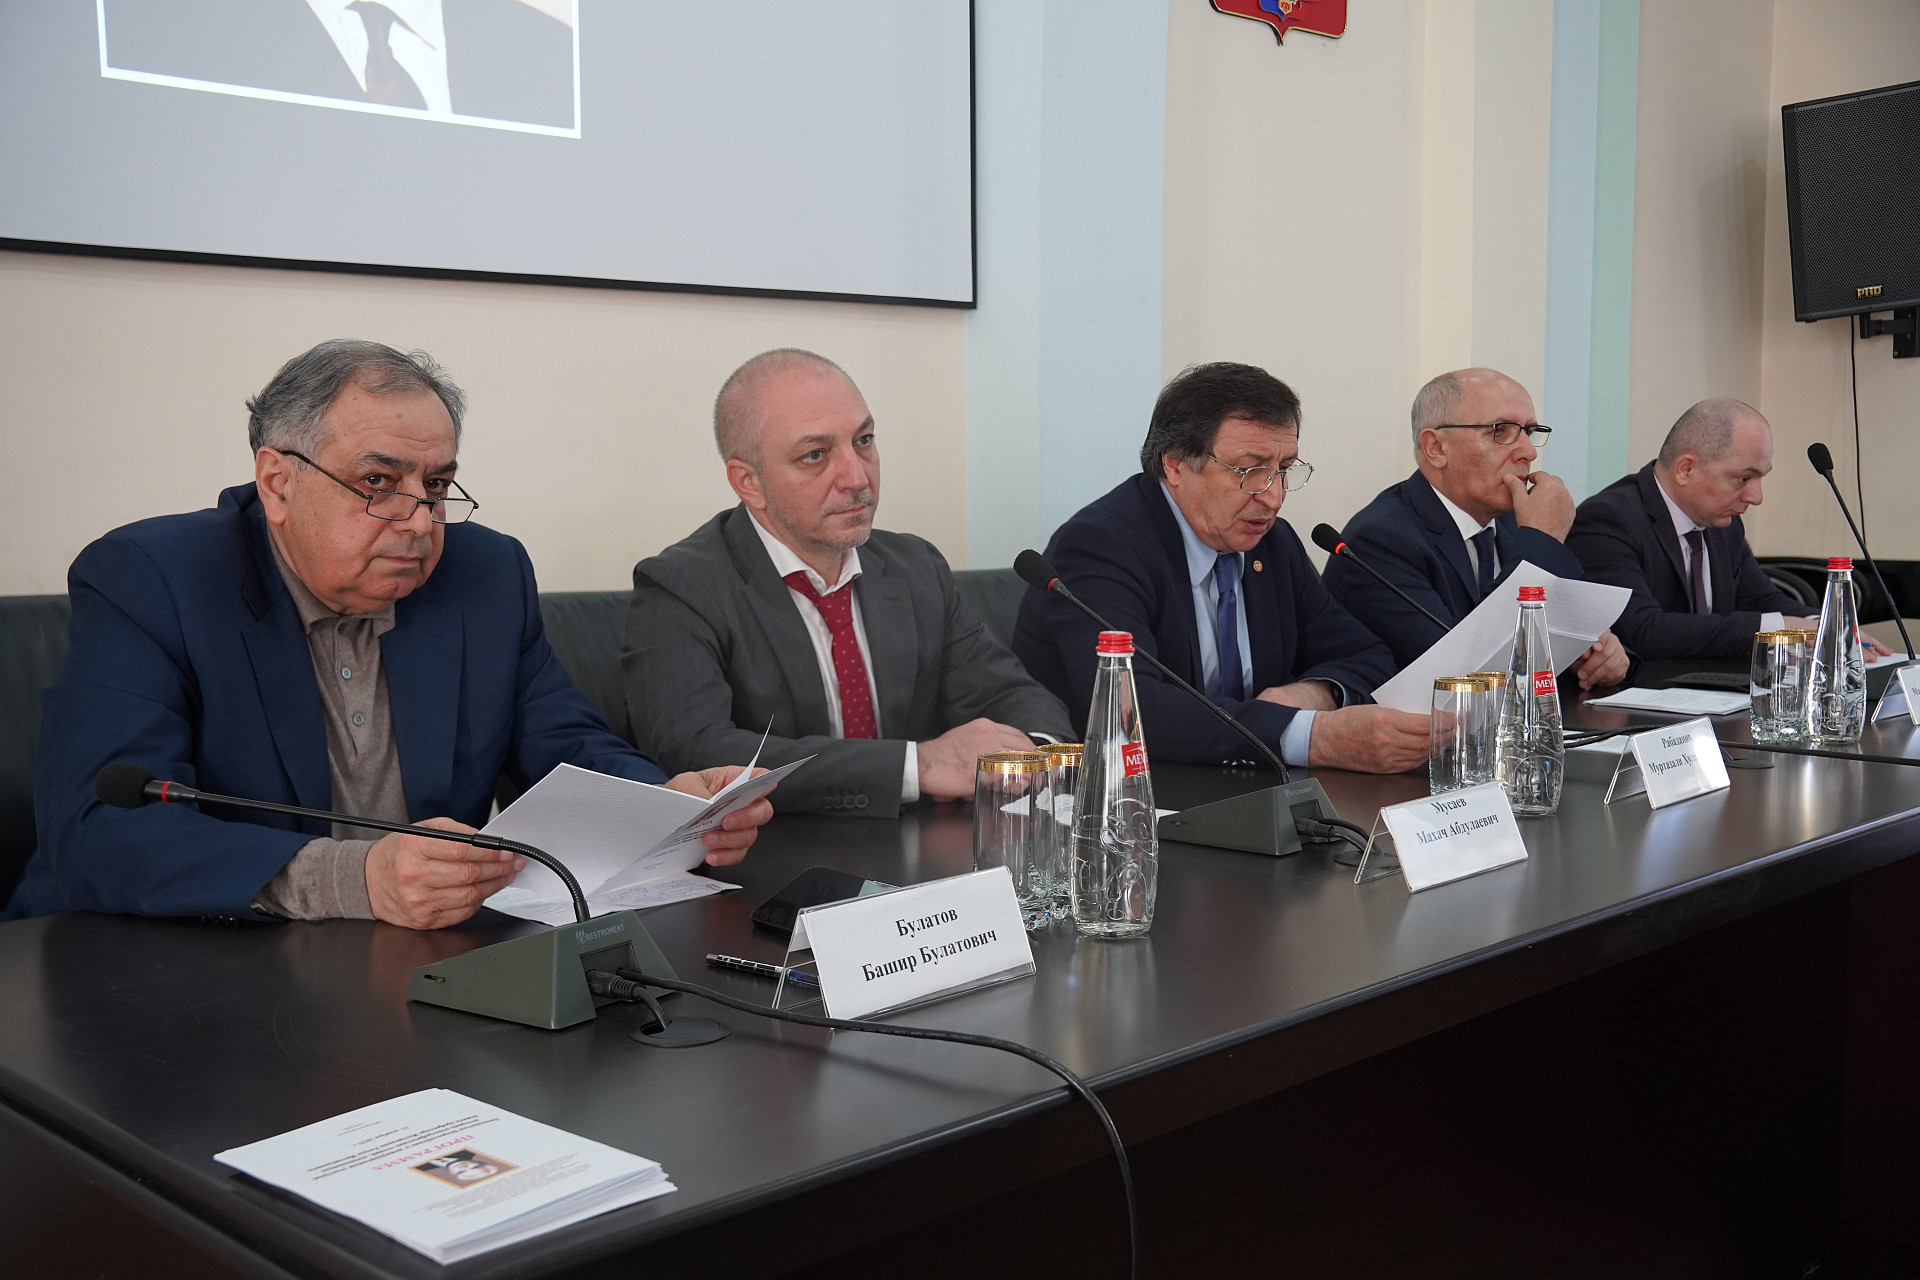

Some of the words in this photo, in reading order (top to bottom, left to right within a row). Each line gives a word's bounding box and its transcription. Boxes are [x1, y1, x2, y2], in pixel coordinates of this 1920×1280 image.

[1431, 798, 1467, 815] Мусаев
[1416, 829, 1448, 845] Махач
[1450, 814, 1499, 835] Абдулаевич
[895, 909, 958, 938] Булатов
[861, 955, 917, 982] Башир
[919, 930, 998, 965] Булатович
